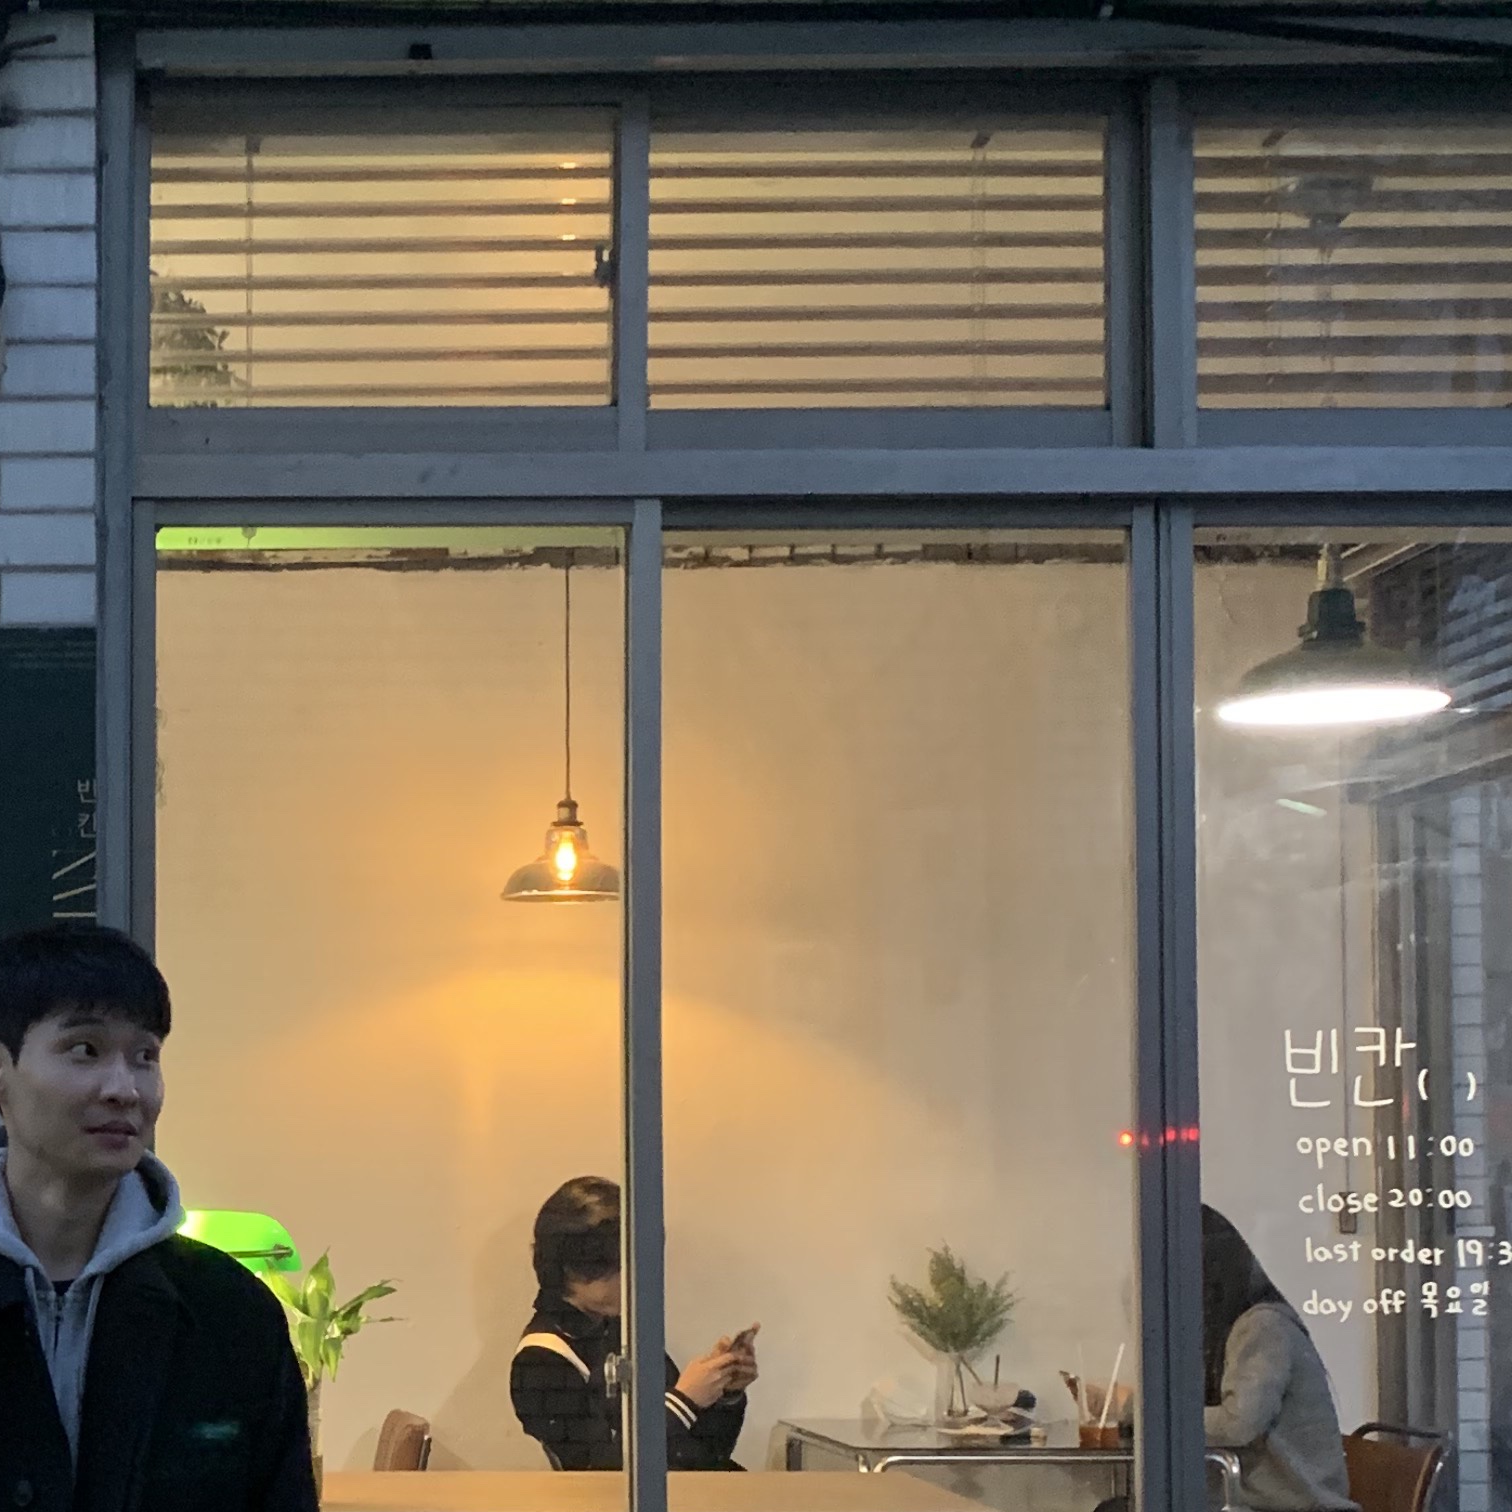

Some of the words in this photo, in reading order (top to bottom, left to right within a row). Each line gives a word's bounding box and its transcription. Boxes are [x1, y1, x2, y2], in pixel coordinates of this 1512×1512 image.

[1296, 1136, 1372, 1169] open
[1387, 1134, 1475, 1161] 11:00
[1298, 1182, 1379, 1214] close
[1388, 1188, 1473, 1209] 20:00
[1305, 1236, 1361, 1263] last
[1370, 1238, 1445, 1266] order
[1302, 1289, 1353, 1323] day
[1362, 1288, 1407, 1315] off
[1420, 1280, 1490, 1319] 목요일
